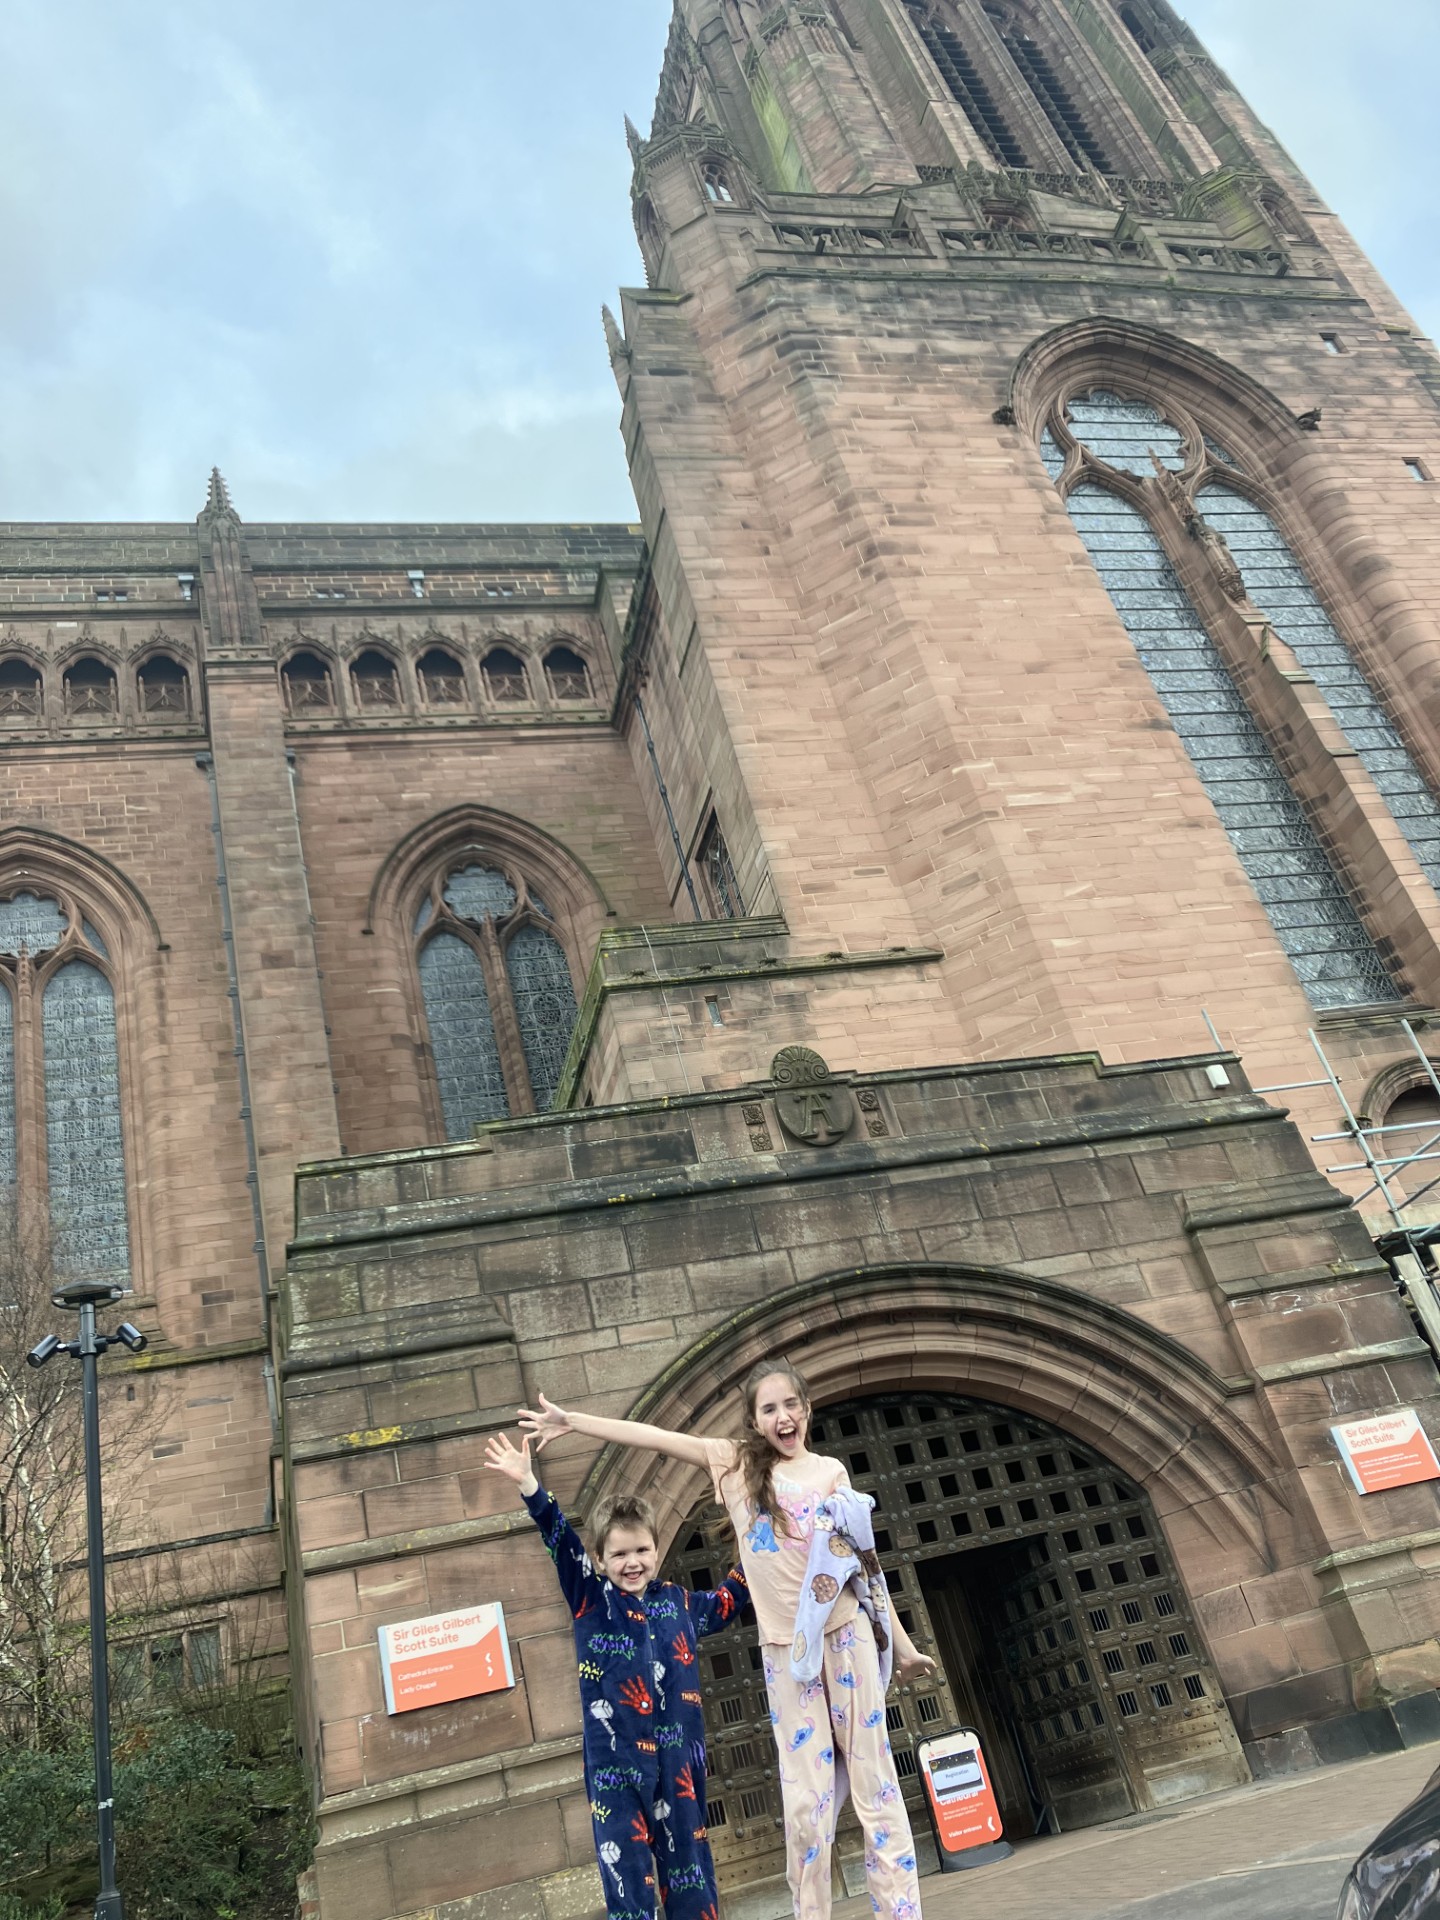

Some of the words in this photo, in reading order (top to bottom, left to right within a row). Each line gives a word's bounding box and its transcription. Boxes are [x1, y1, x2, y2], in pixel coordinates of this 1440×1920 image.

[1345, 1429, 1357, 1439] Sir
[1358, 1426, 1378, 1437] Giles
[1379, 1419, 1407, 1431] Gilbert
[1350, 1437, 1373, 1448] Scott
[1374, 1433, 1395, 1444] Suite
[393, 1629, 411, 1641] Sir
[412, 1624, 440, 1636] Giles
[442, 1615, 480, 1630] Gilbert
[394, 1639, 426, 1654] Scott
[429, 1632, 459, 1647] Suite
[398, 1668, 427, 1681] Cathedral
[427, 1664, 454, 1675] Entrance
[399, 1687, 415, 1695] Lady
[416, 1681, 437, 1692] Chapel
